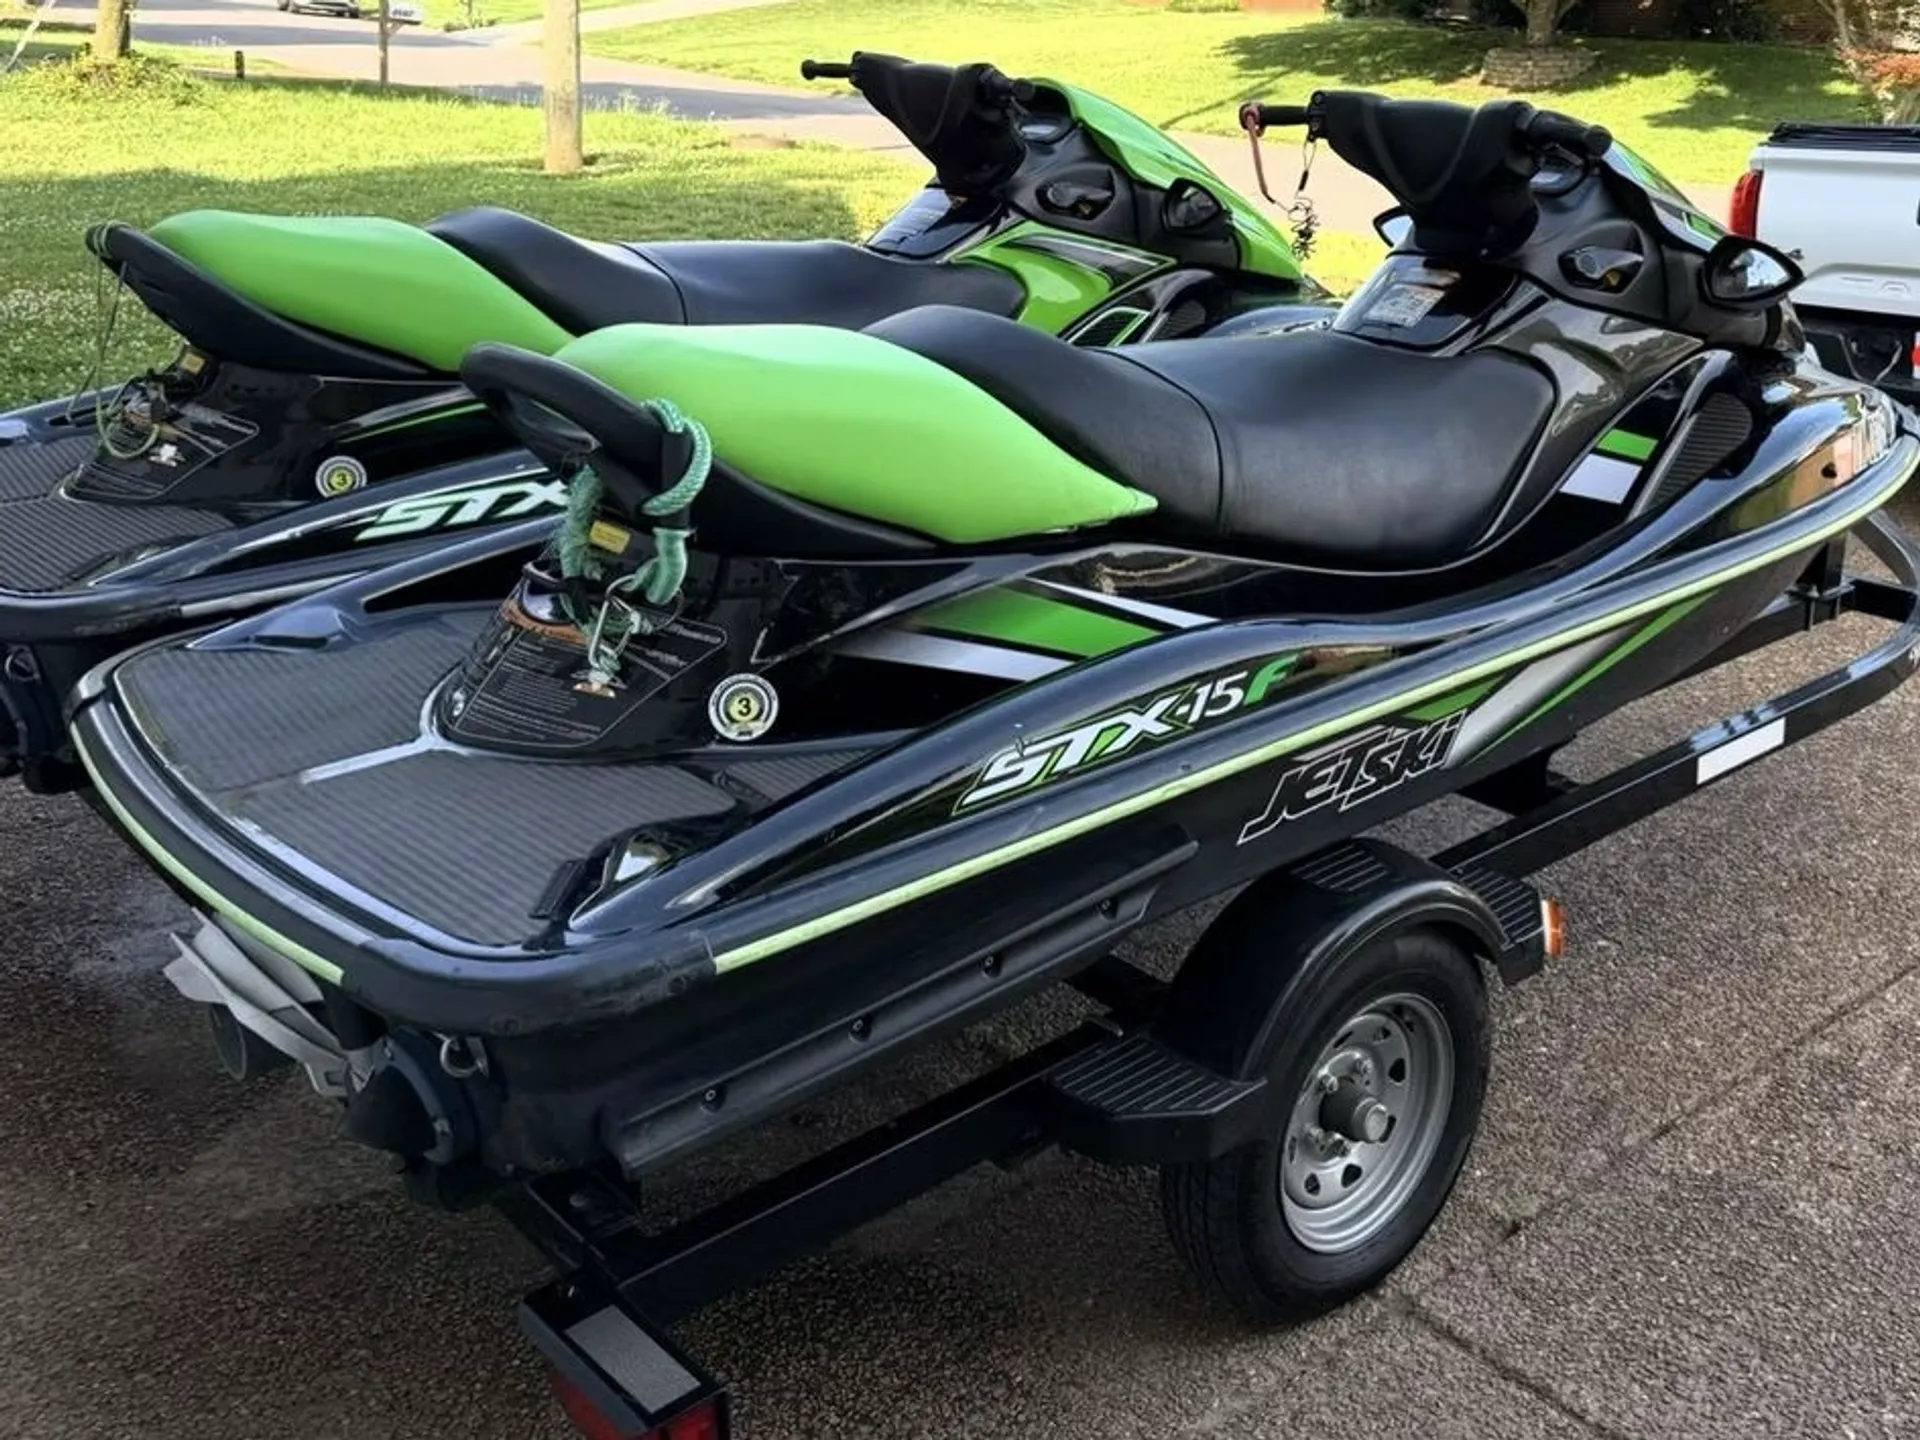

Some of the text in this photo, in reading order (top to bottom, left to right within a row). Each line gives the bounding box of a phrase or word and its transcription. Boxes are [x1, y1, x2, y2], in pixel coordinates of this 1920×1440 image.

[336, 473, 348, 487] 3
[354, 479, 569, 542] STX
[738, 697, 752, 717] 3
